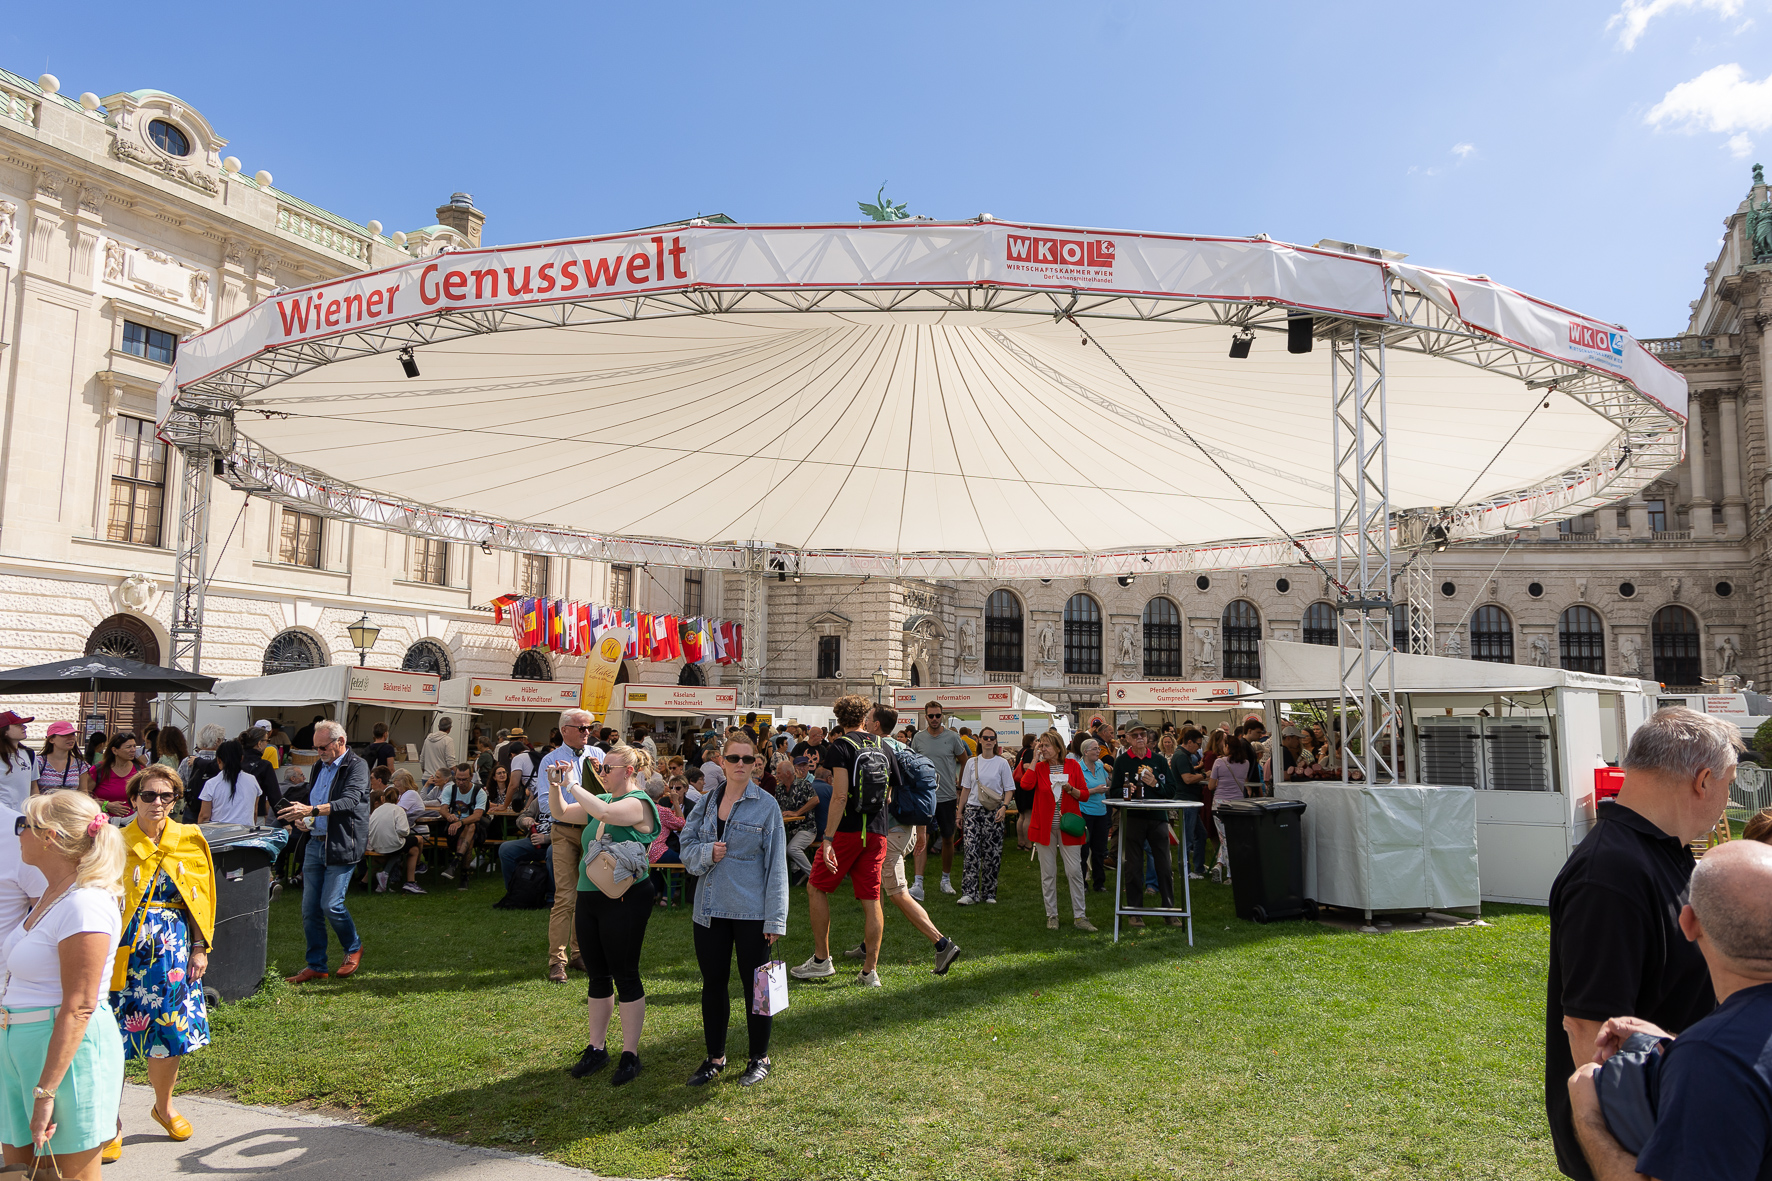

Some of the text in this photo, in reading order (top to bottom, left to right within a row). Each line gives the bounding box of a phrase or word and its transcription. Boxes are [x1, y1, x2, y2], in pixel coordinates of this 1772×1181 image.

[1006, 263, 1091, 275] WIRTSCHAFTSKAMMER
[276, 235, 688, 337] Wiener Genusswelt
[383, 682, 412, 692] Bäckerei Felzl
